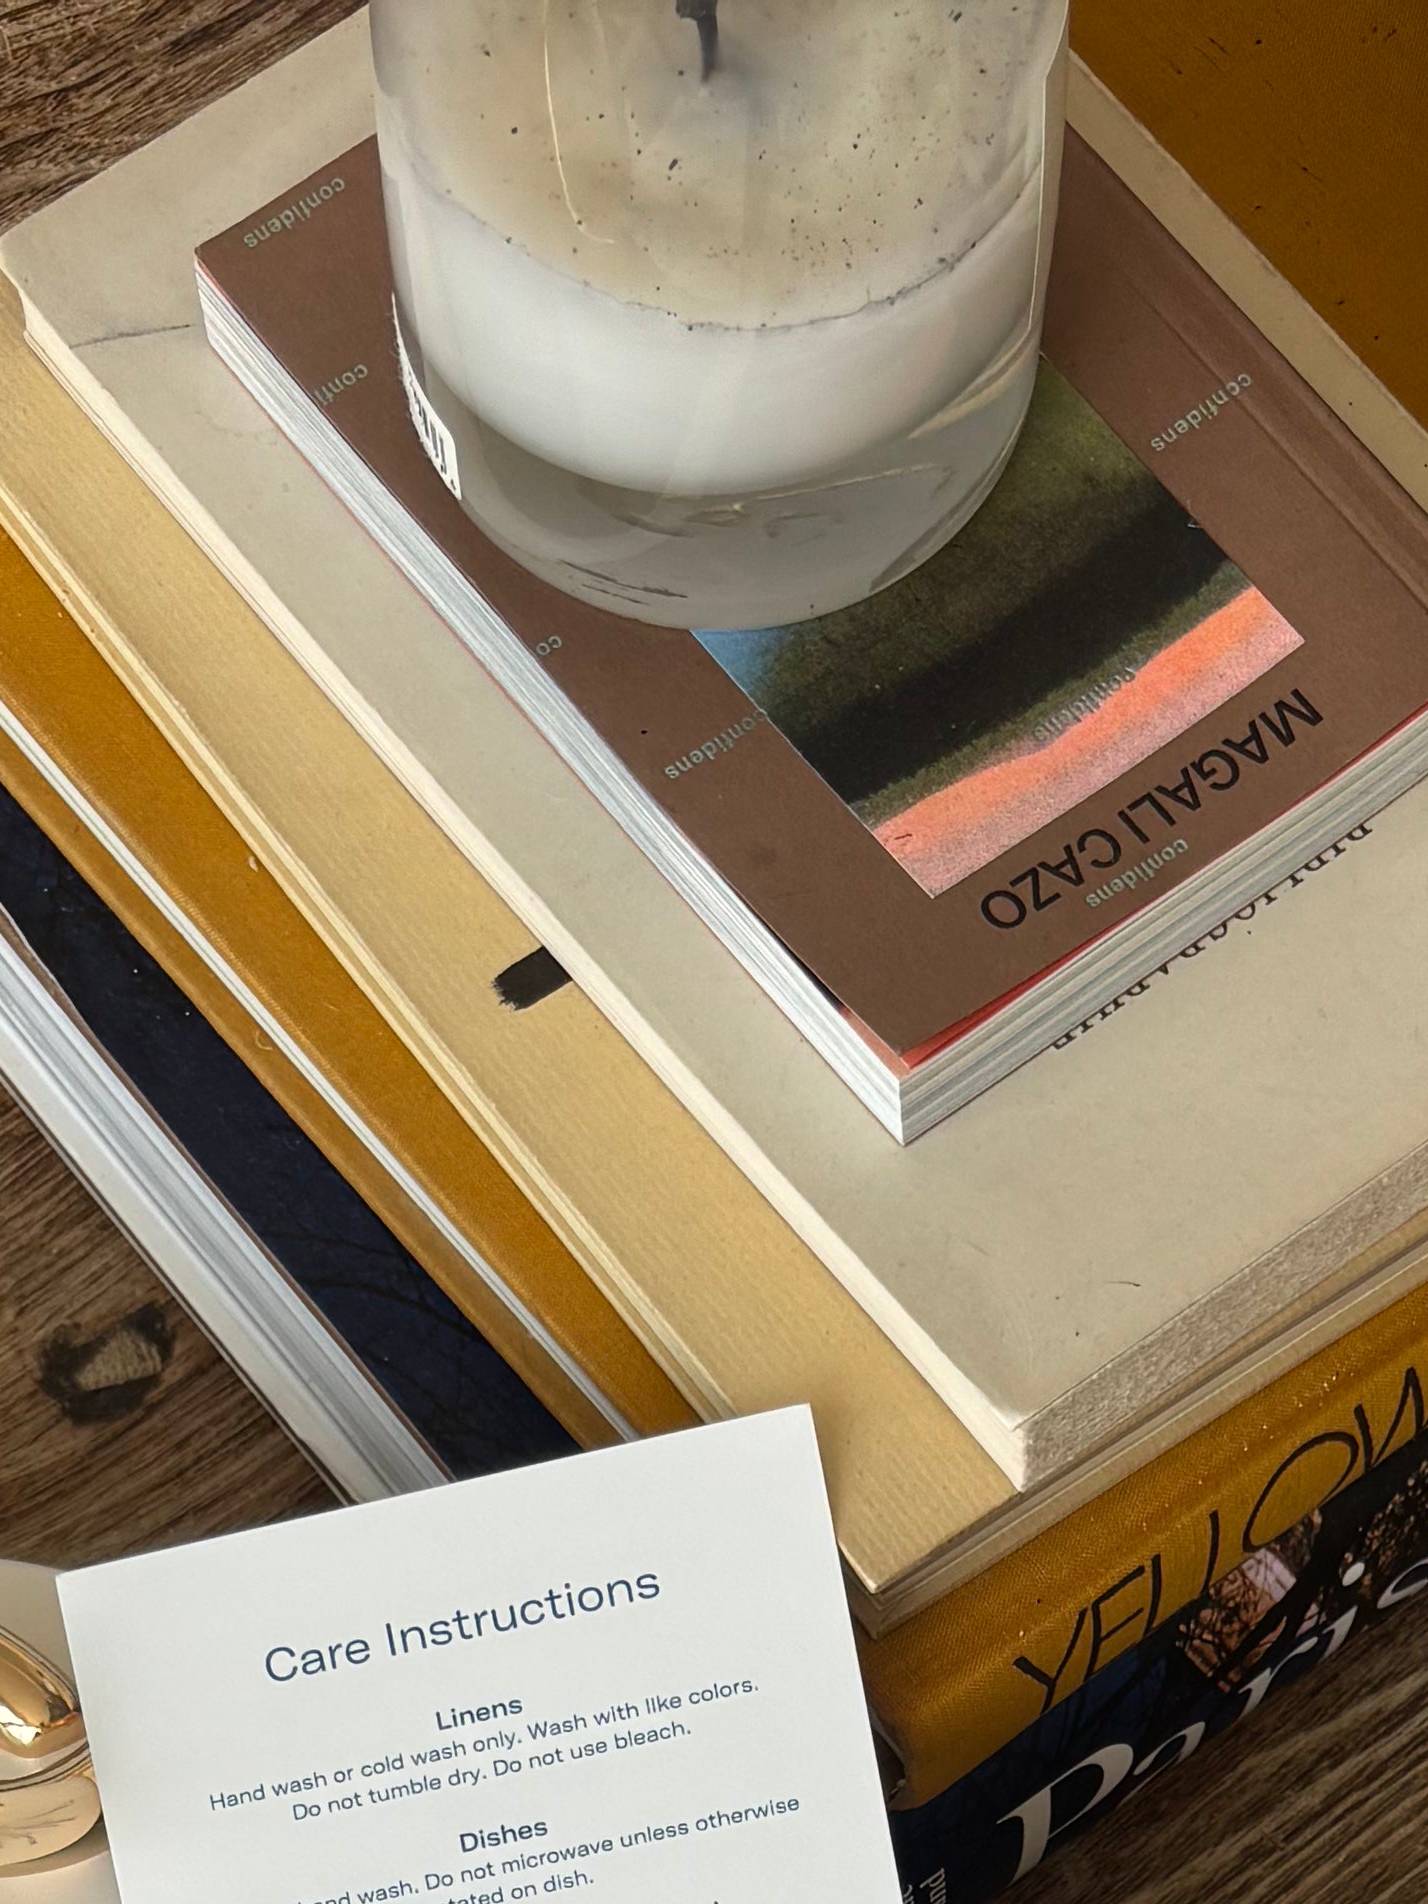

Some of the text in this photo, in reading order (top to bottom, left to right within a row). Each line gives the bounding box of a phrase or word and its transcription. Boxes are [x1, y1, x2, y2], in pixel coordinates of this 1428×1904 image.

[243, 177, 345, 249] confidens
[1149, 372, 1252, 453] confidens
[1117, 687, 1325, 847] MAGALI
[980, 828, 1123, 931] CAZO
[1084, 837, 1190, 911] confidens
[264, 1572, 661, 1683] Care Instructions
[208, 1679, 760, 1812] Hand wash or cold wash only. Wash with like colors.
[434, 1698, 524, 1732] Linens
[291, 1720, 692, 1822] Do not tumble dry. Do not use bleach.
[423, 1872, 455, 1892] Do
[459, 1861, 497, 1884] not
[500, 1838, 615, 1875] microwave
[619, 1821, 690, 1849] unless
[694, 1797, 801, 1833] otherwise
[458, 1820, 550, 1855] Dishes
[509, 1883, 538, 1901] on
[542, 1868, 595, 1894] dish.
